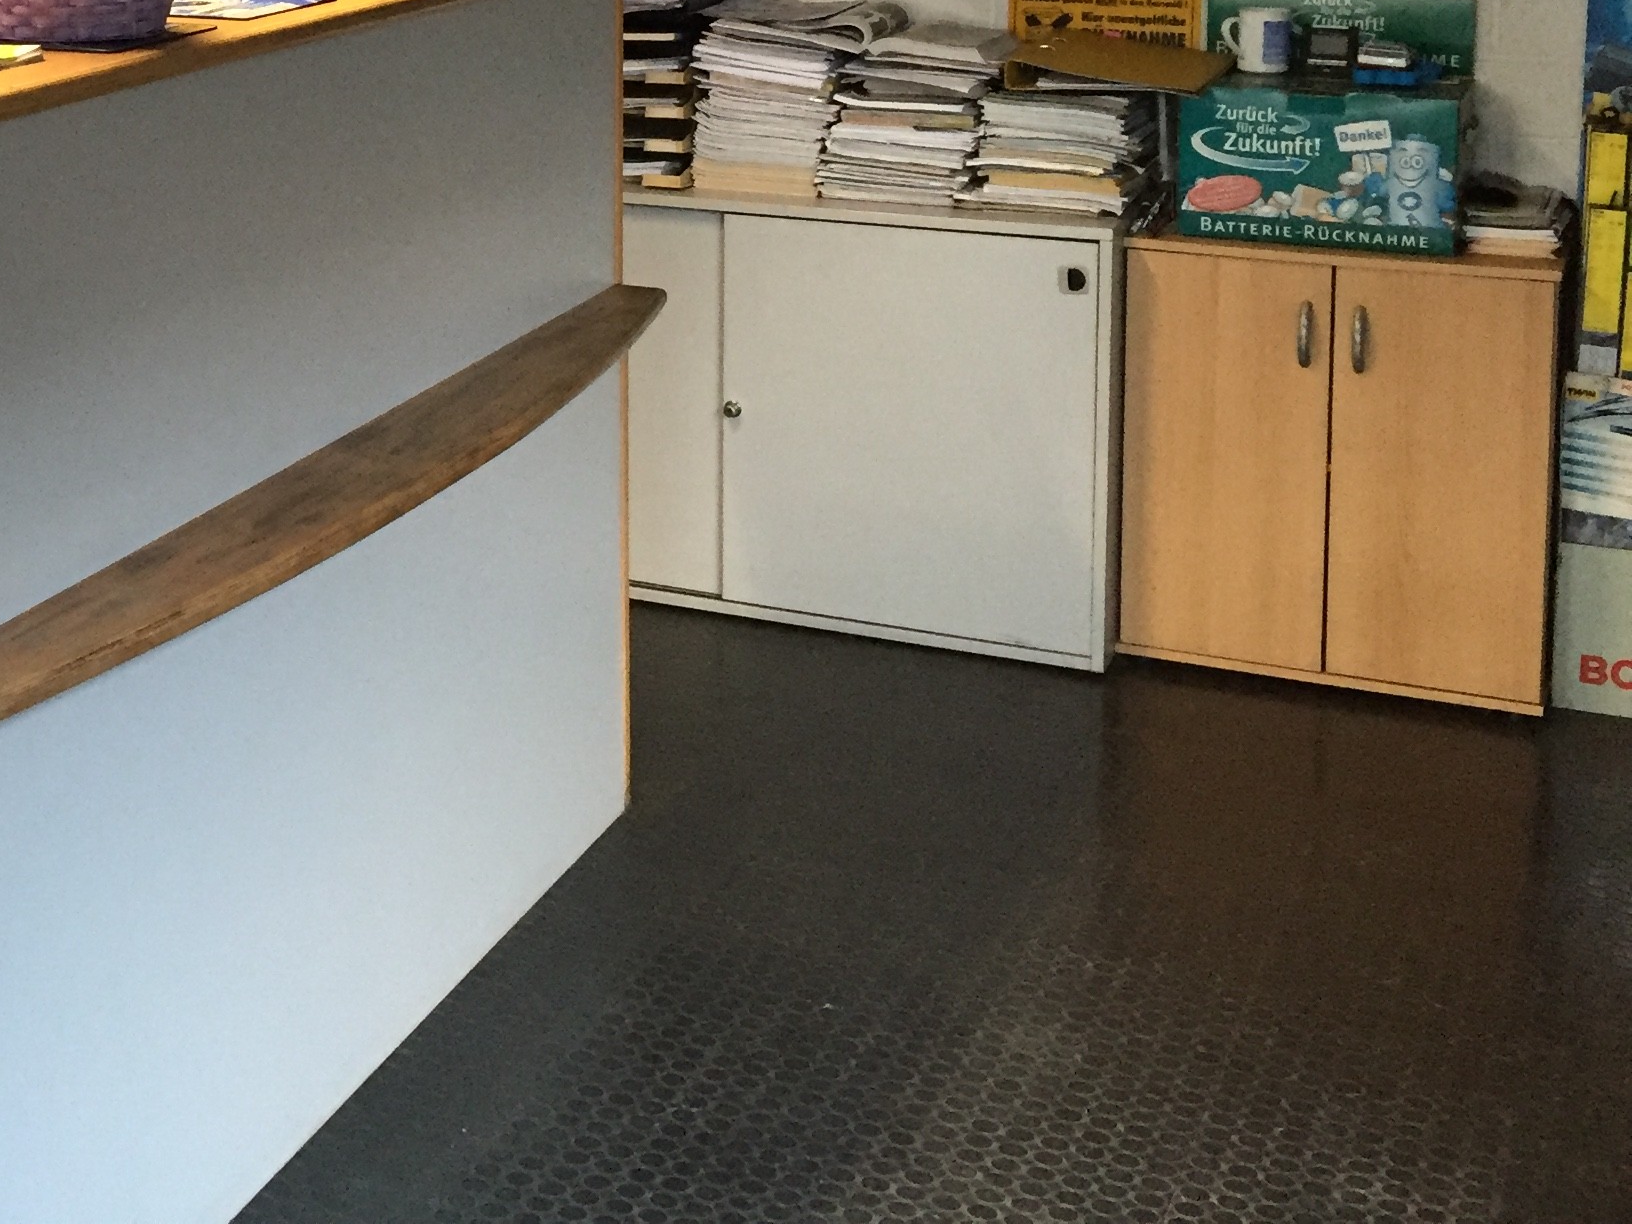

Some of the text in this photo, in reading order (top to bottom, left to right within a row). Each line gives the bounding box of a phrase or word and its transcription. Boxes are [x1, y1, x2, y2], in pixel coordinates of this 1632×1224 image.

[1081, 11, 1105, 23] Hier
[1311, 14, 1385, 32] Zukunft!
[1215, 104, 1278, 124] Zurück
[1235, 121, 1277, 136] für die
[1338, 126, 1388, 144] Danke!
[1222, 132, 1321, 157] Zukunft!
[1200, 216, 1430, 250] BATTERIE-RÜCKNAHME
